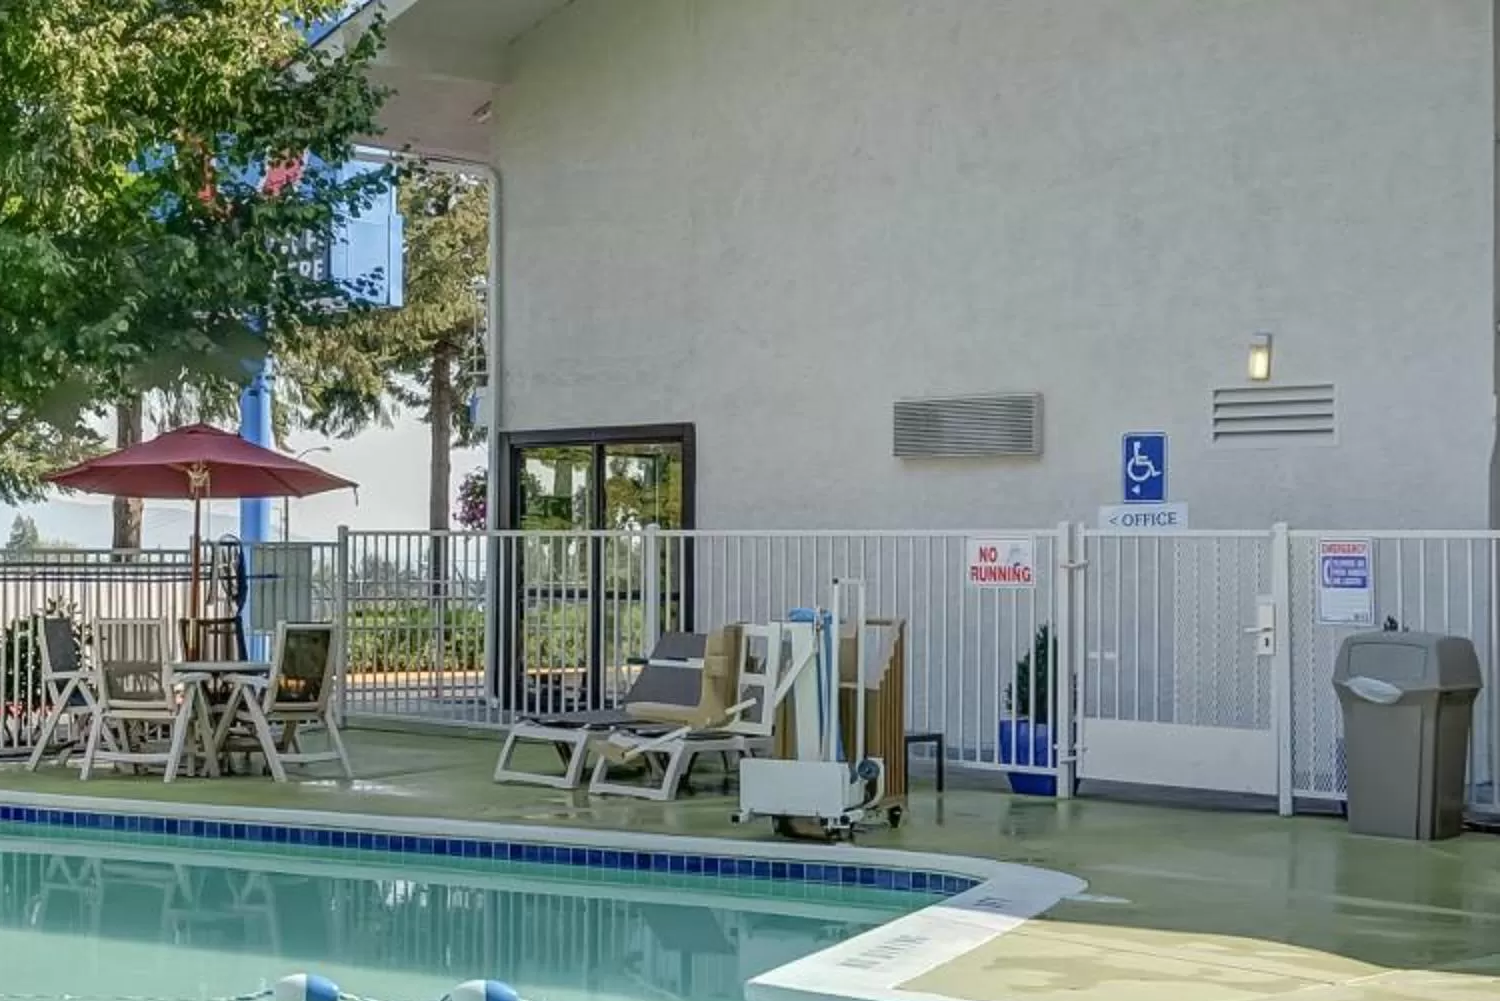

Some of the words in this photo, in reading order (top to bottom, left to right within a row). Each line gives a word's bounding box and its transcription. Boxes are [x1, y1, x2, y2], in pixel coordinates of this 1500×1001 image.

[1121, 511, 1178, 527] OFFICE
[979, 546, 998, 562] NO
[970, 565, 1031, 582] RUNNING
